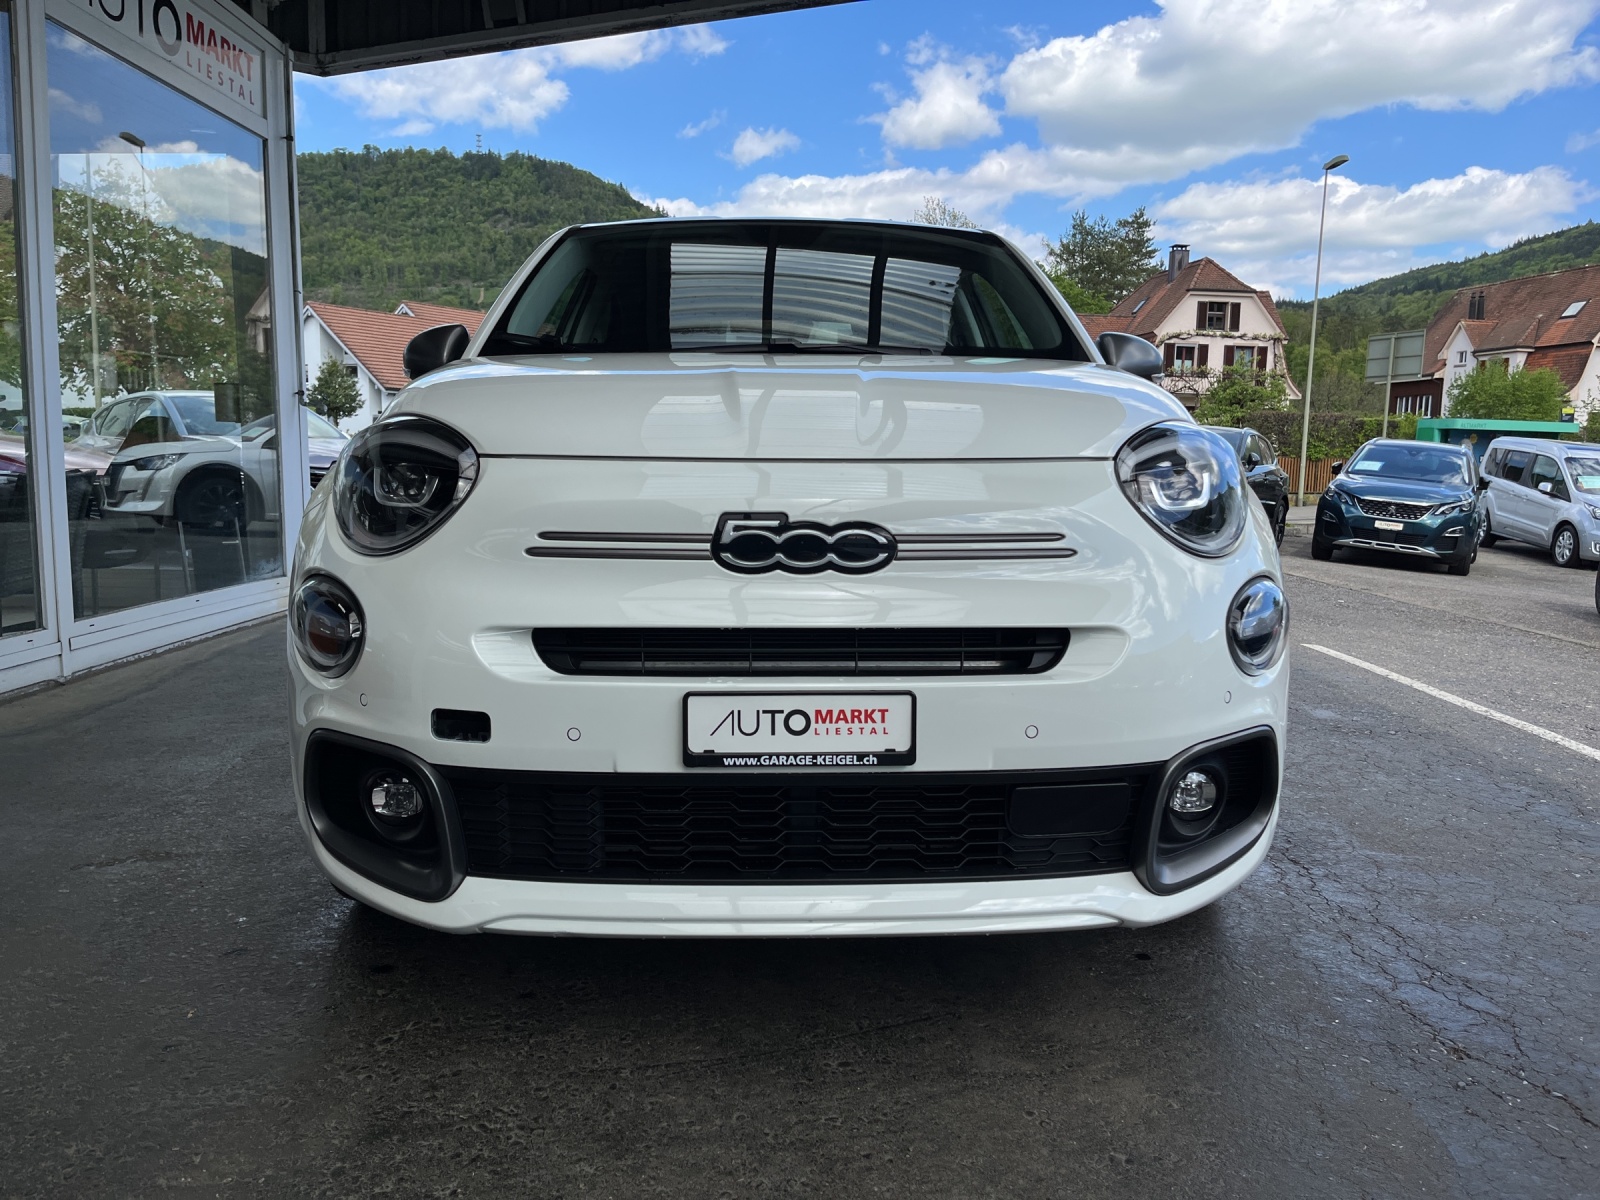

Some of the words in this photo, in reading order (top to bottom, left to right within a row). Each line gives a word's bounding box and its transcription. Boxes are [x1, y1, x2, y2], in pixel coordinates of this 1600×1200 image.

[186, 11, 254, 83] MARKT
[186, 50, 255, 106] LIESTAL
[714, 513, 896, 573] 500
[710, 708, 812, 736] AUTO
[814, 708, 889, 725] MARKT
[814, 726, 889, 736] LIESTAL
[723, 754, 878, 766] www.GARAGE-KEIGEL.ch
